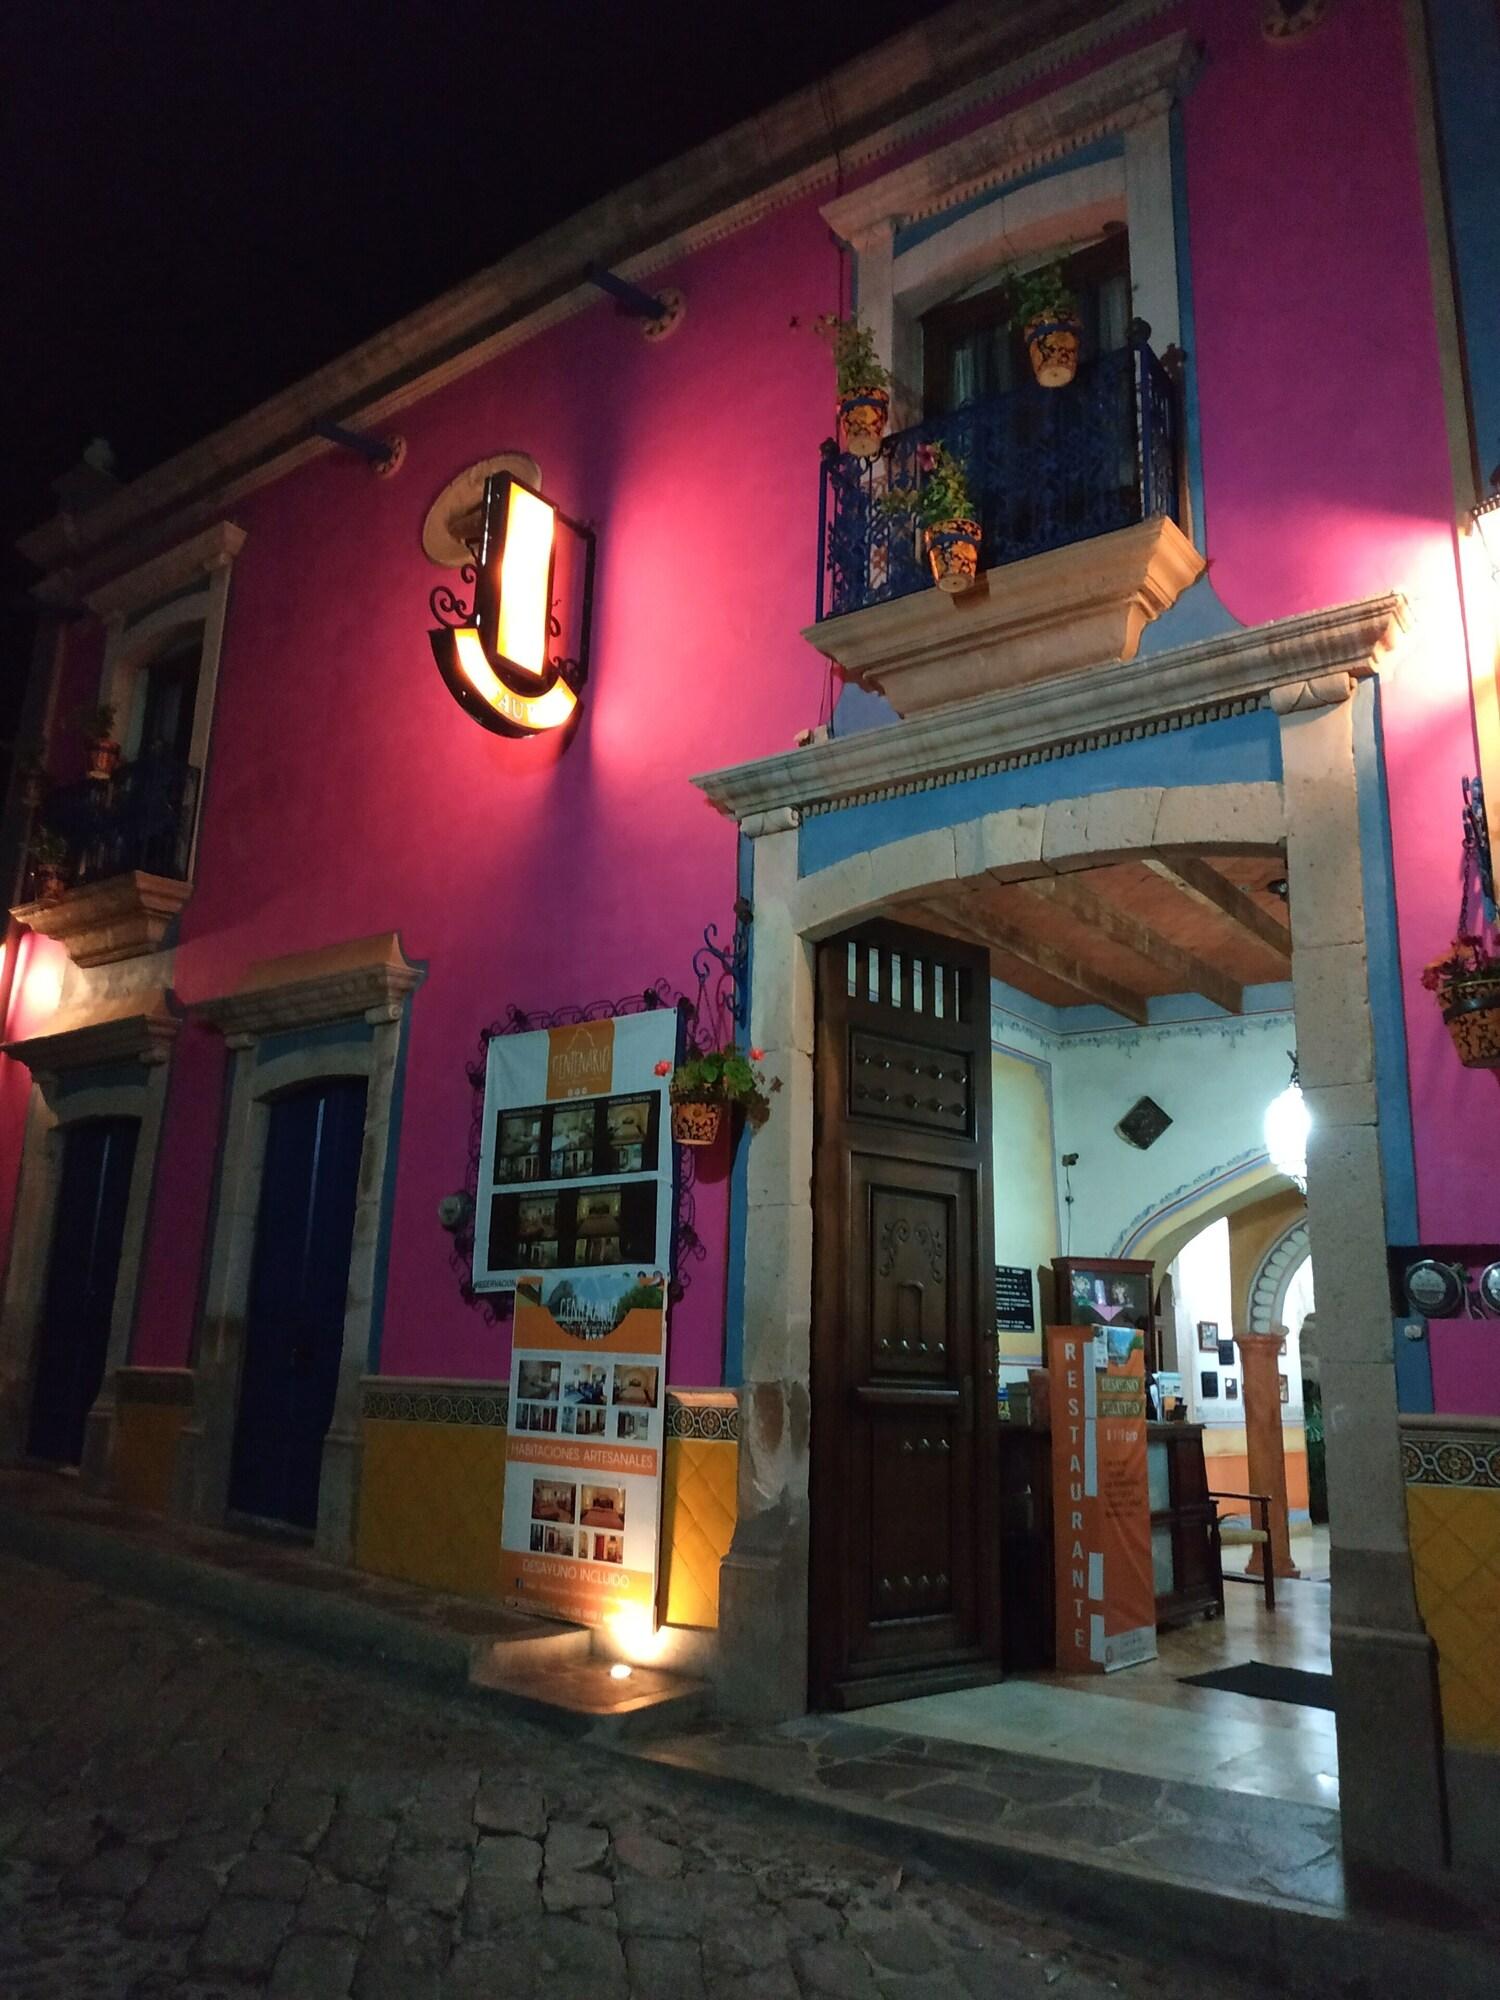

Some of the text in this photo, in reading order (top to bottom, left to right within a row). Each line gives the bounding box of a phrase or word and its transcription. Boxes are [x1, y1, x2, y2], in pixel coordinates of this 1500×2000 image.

[511, 1442, 654, 1469] HABITACIONES ARTESANALES
[1064, 1342, 1086, 1648] RESTAURANTE
[522, 1559, 630, 1589] DESAYUNO INCLUIDO
